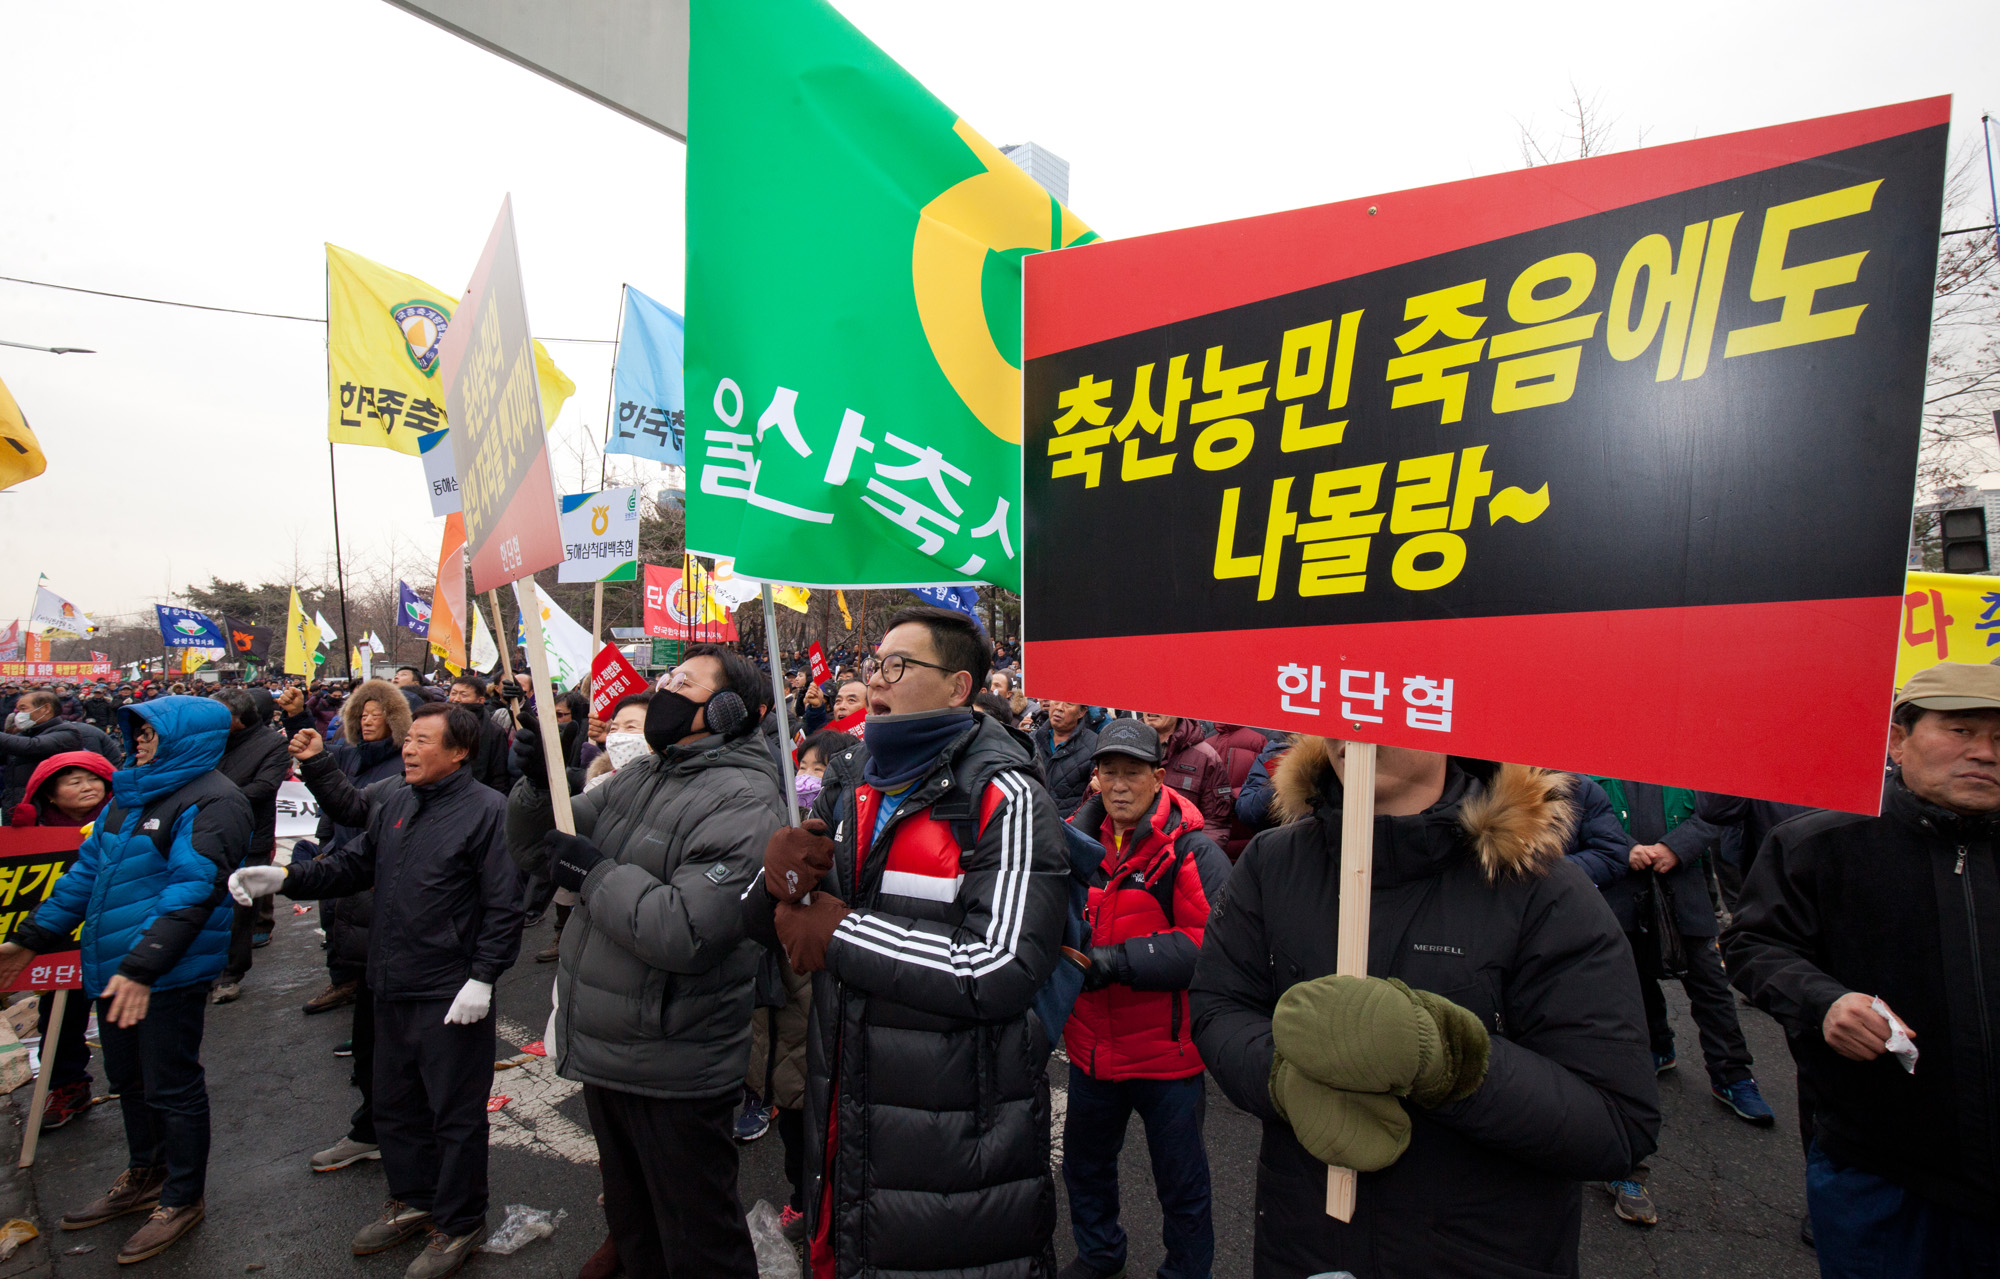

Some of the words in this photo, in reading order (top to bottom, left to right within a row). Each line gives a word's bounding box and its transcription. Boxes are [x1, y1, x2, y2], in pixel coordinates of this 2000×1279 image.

[1048, 309, 1364, 489] 축산농민
[1386, 178, 1884, 425] 죽음에도
[462, 287, 504, 442] 축산농민의
[476, 414, 506, 516] 자리를
[1213, 444, 1551, 601] 나몰랑~
[500, 534, 523, 572] 한단협
[565, 540, 634, 561] 동해삼척태백축협
[37, 664, 54, 676] 위한
[600, 660, 622, 680] 적법화
[605, 680, 625, 699] 제정
[1276, 661, 1455, 733] 한단협
[1413, 943, 1465, 956] MERRELL
